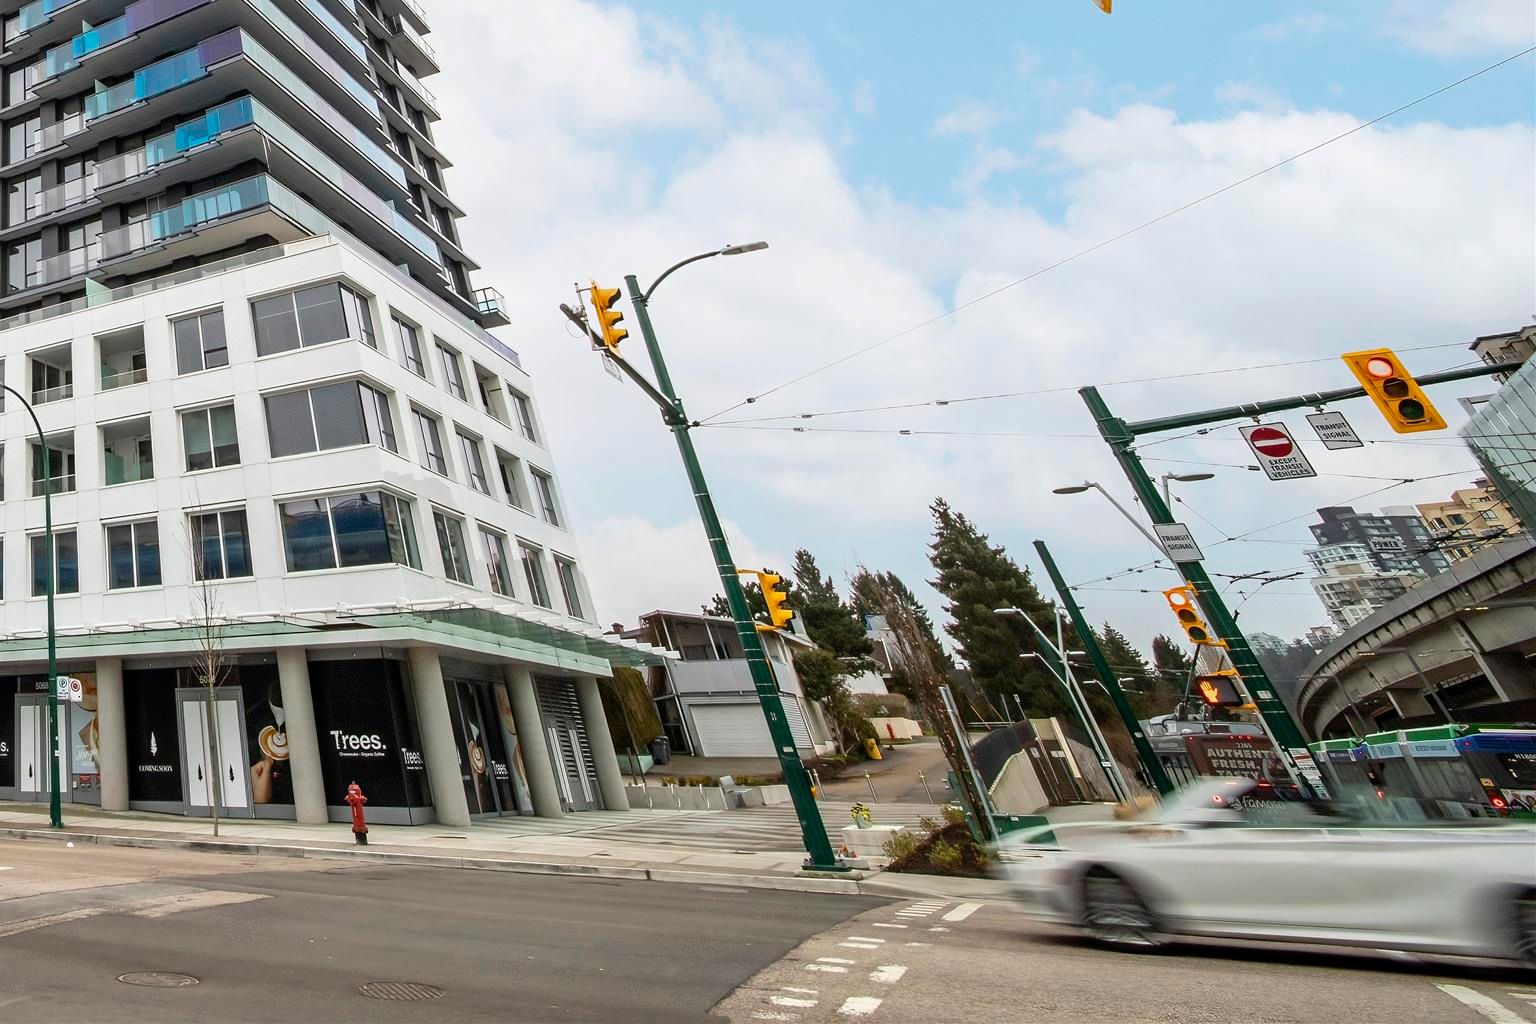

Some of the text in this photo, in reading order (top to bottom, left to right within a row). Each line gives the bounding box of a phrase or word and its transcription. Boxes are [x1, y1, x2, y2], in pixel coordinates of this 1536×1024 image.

[1316, 422, 1347, 431] TRANSIT
[1323, 431, 1351, 439] SIGNAL
[1269, 457, 1298, 466] EXCEPT
[1271, 463, 1305, 472] TRANSIT
[1272, 469, 1311, 478] VEHICLES
[1161, 534, 1190, 542] TRANSIT
[330, 730, 387, 750] Trees.
[1212, 759, 1261, 769] FRESH.
